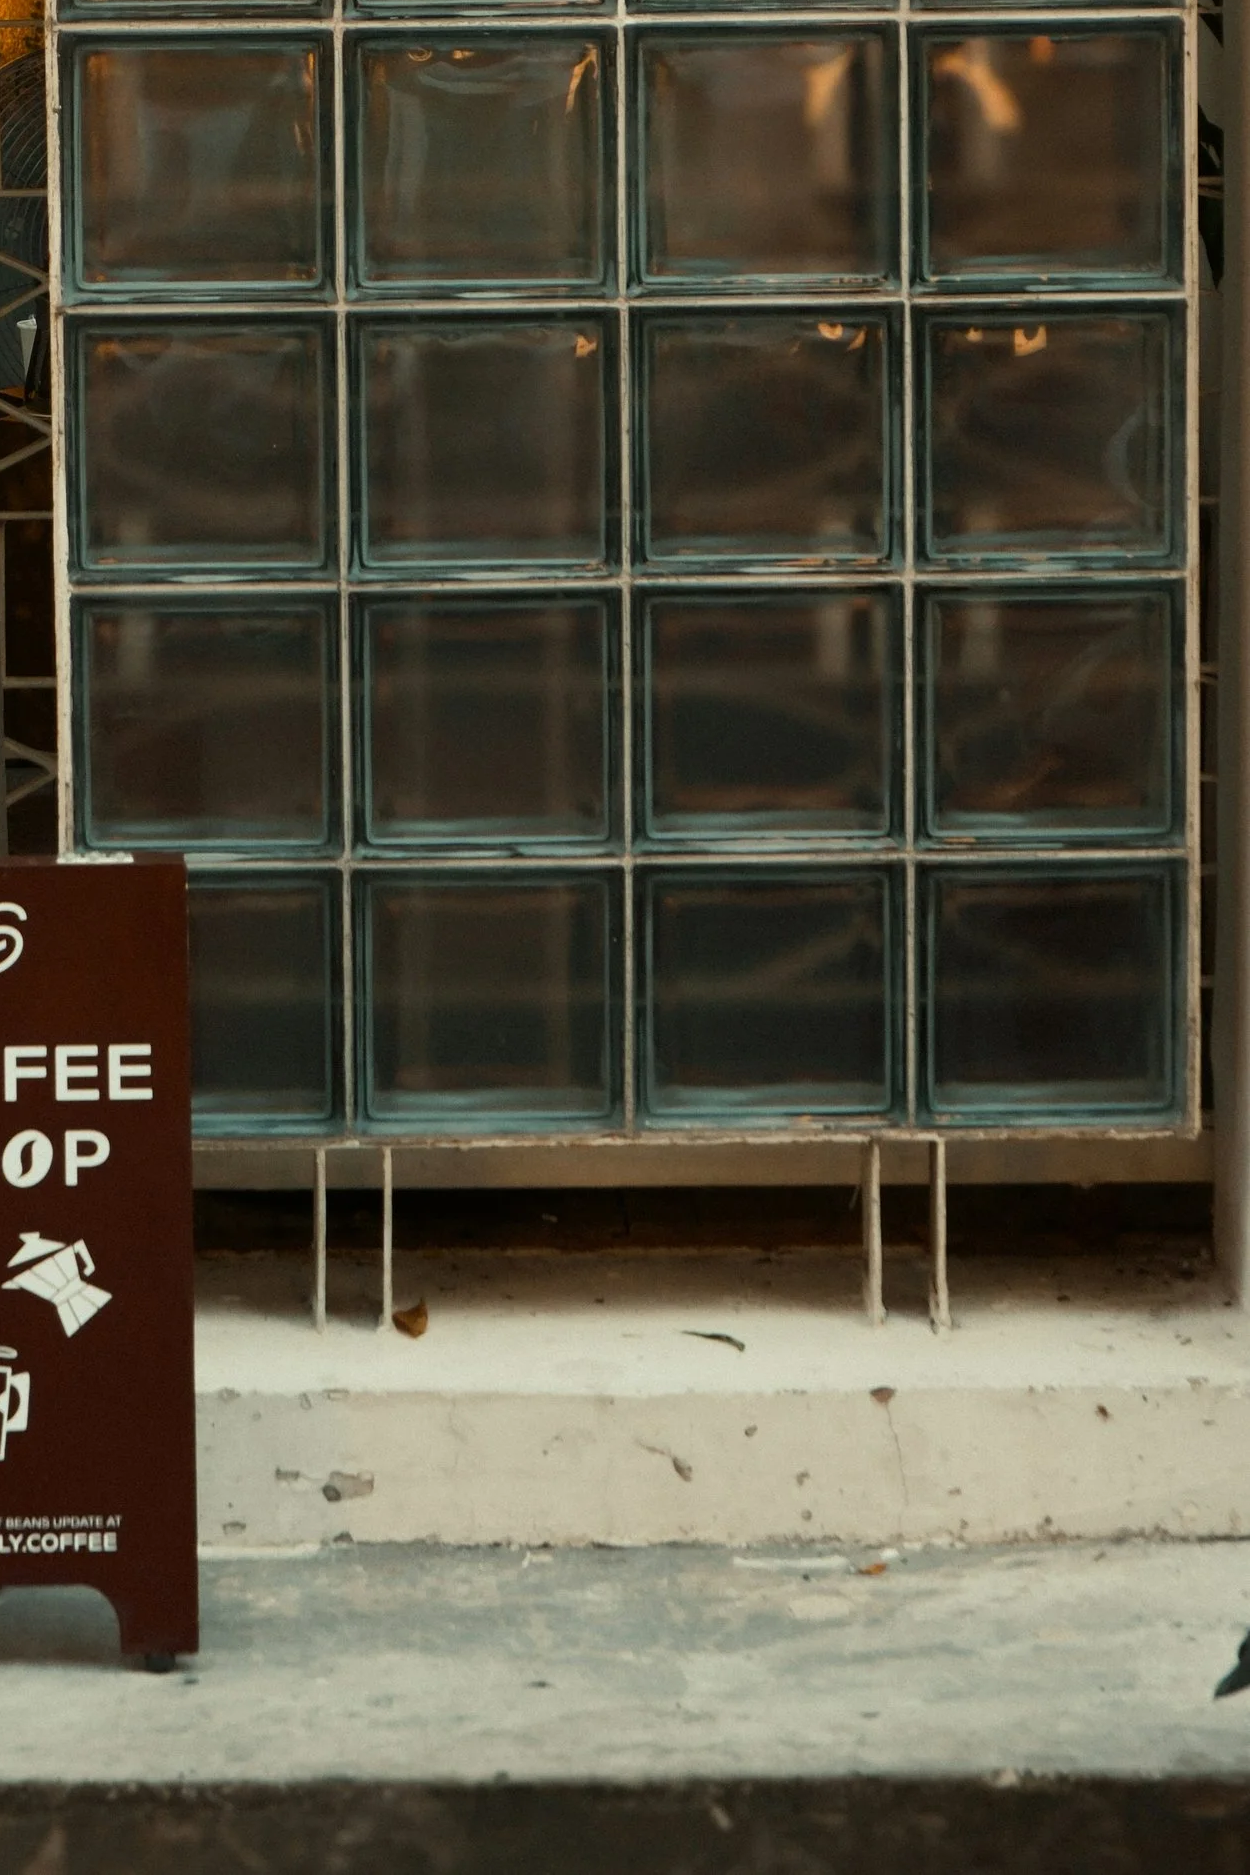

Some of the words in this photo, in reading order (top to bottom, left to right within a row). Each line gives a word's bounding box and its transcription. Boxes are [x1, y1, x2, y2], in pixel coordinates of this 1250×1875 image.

[5, 1516, 50, 1530] BEANS
[53, 1516, 103, 1528] UPDATE
[107, 1515, 121, 1527] AT
